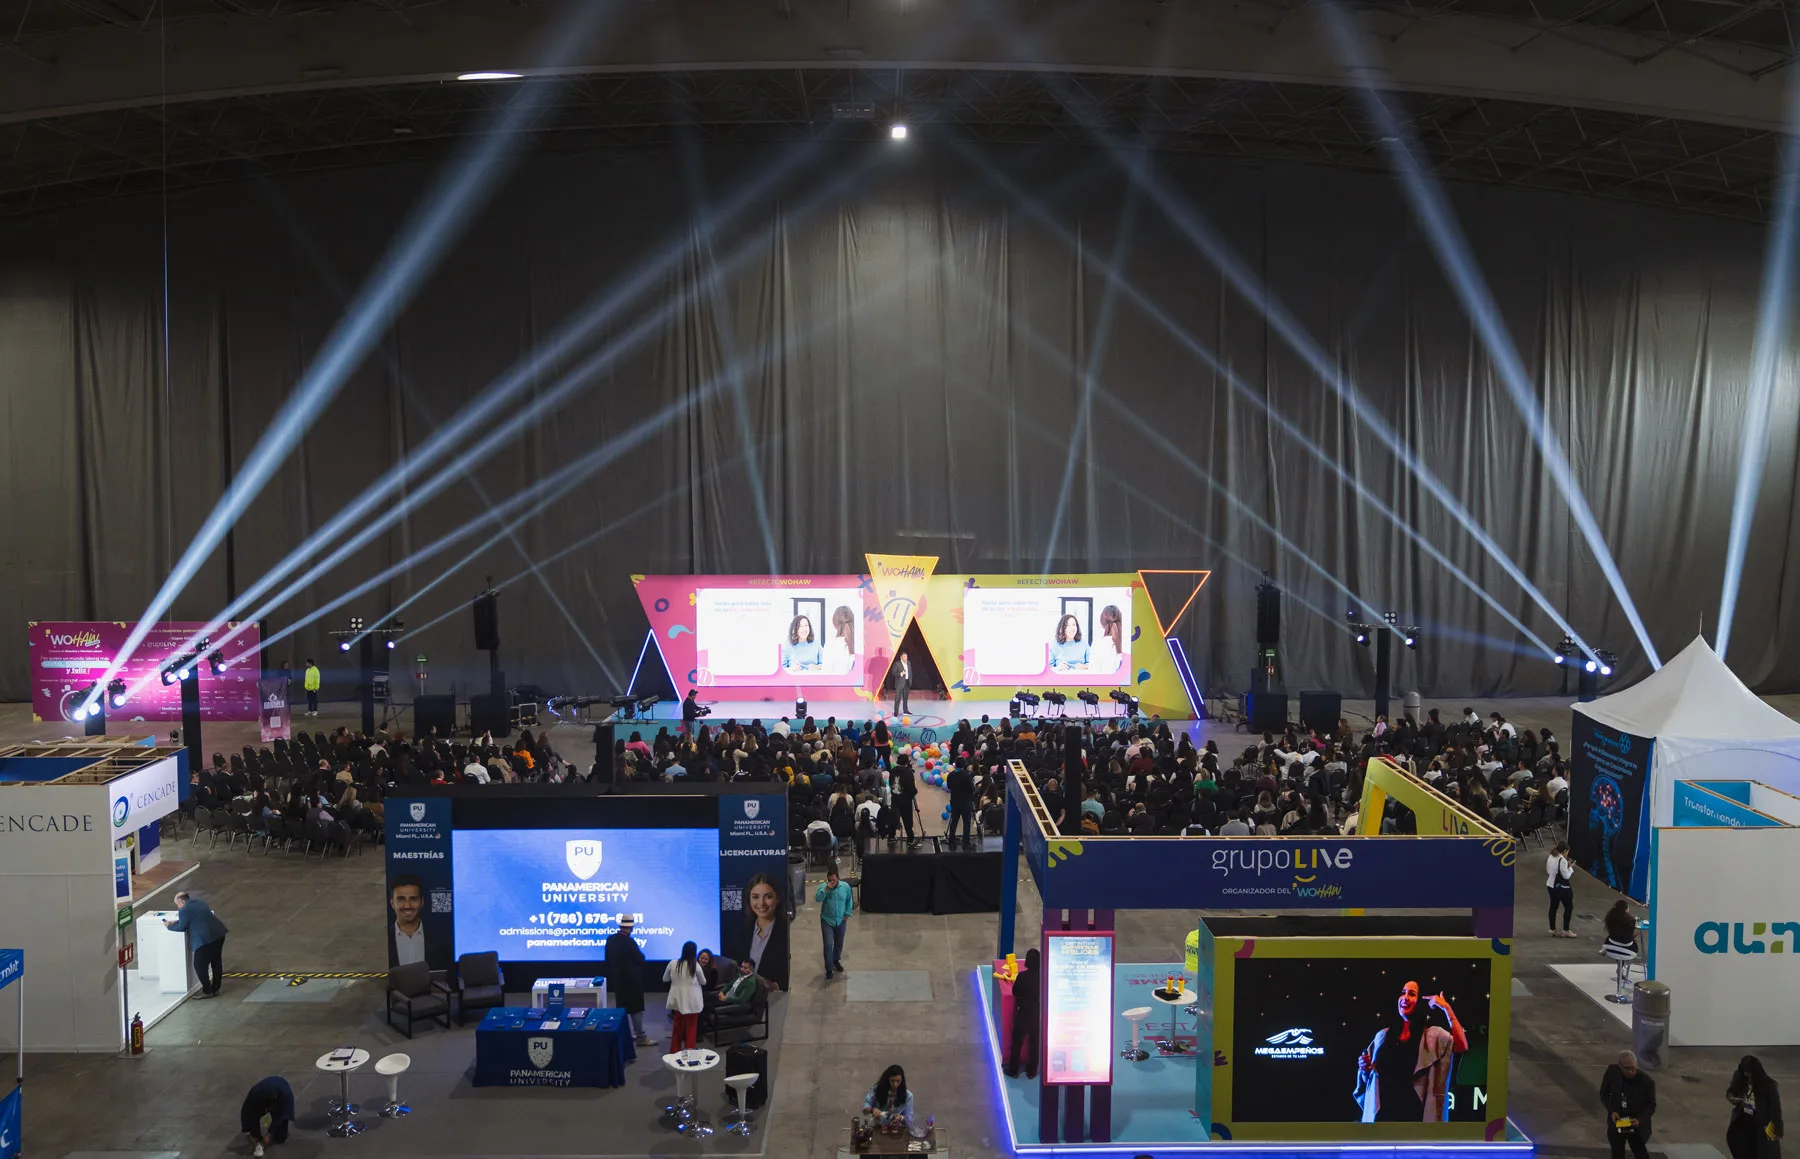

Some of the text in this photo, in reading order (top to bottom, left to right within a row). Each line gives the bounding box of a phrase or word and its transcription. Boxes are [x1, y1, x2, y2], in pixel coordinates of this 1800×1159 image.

[136, 780, 177, 809] CENCADE
[393, 851, 444, 859] MAESTRÍAS
[575, 847, 594, 856] PU
[542, 883, 629, 892] PANAMERICAN
[1222, 887, 1276, 895] ORGANIZADOR
[542, 894, 629, 902] UNIVERSITY
[585, 913, 644, 924] 676-811
[533, 1042, 548, 1050] PU
[510, 1070, 571, 1078] PANAMERICAN
[510, 1078, 571, 1087] UNIVERSITY
